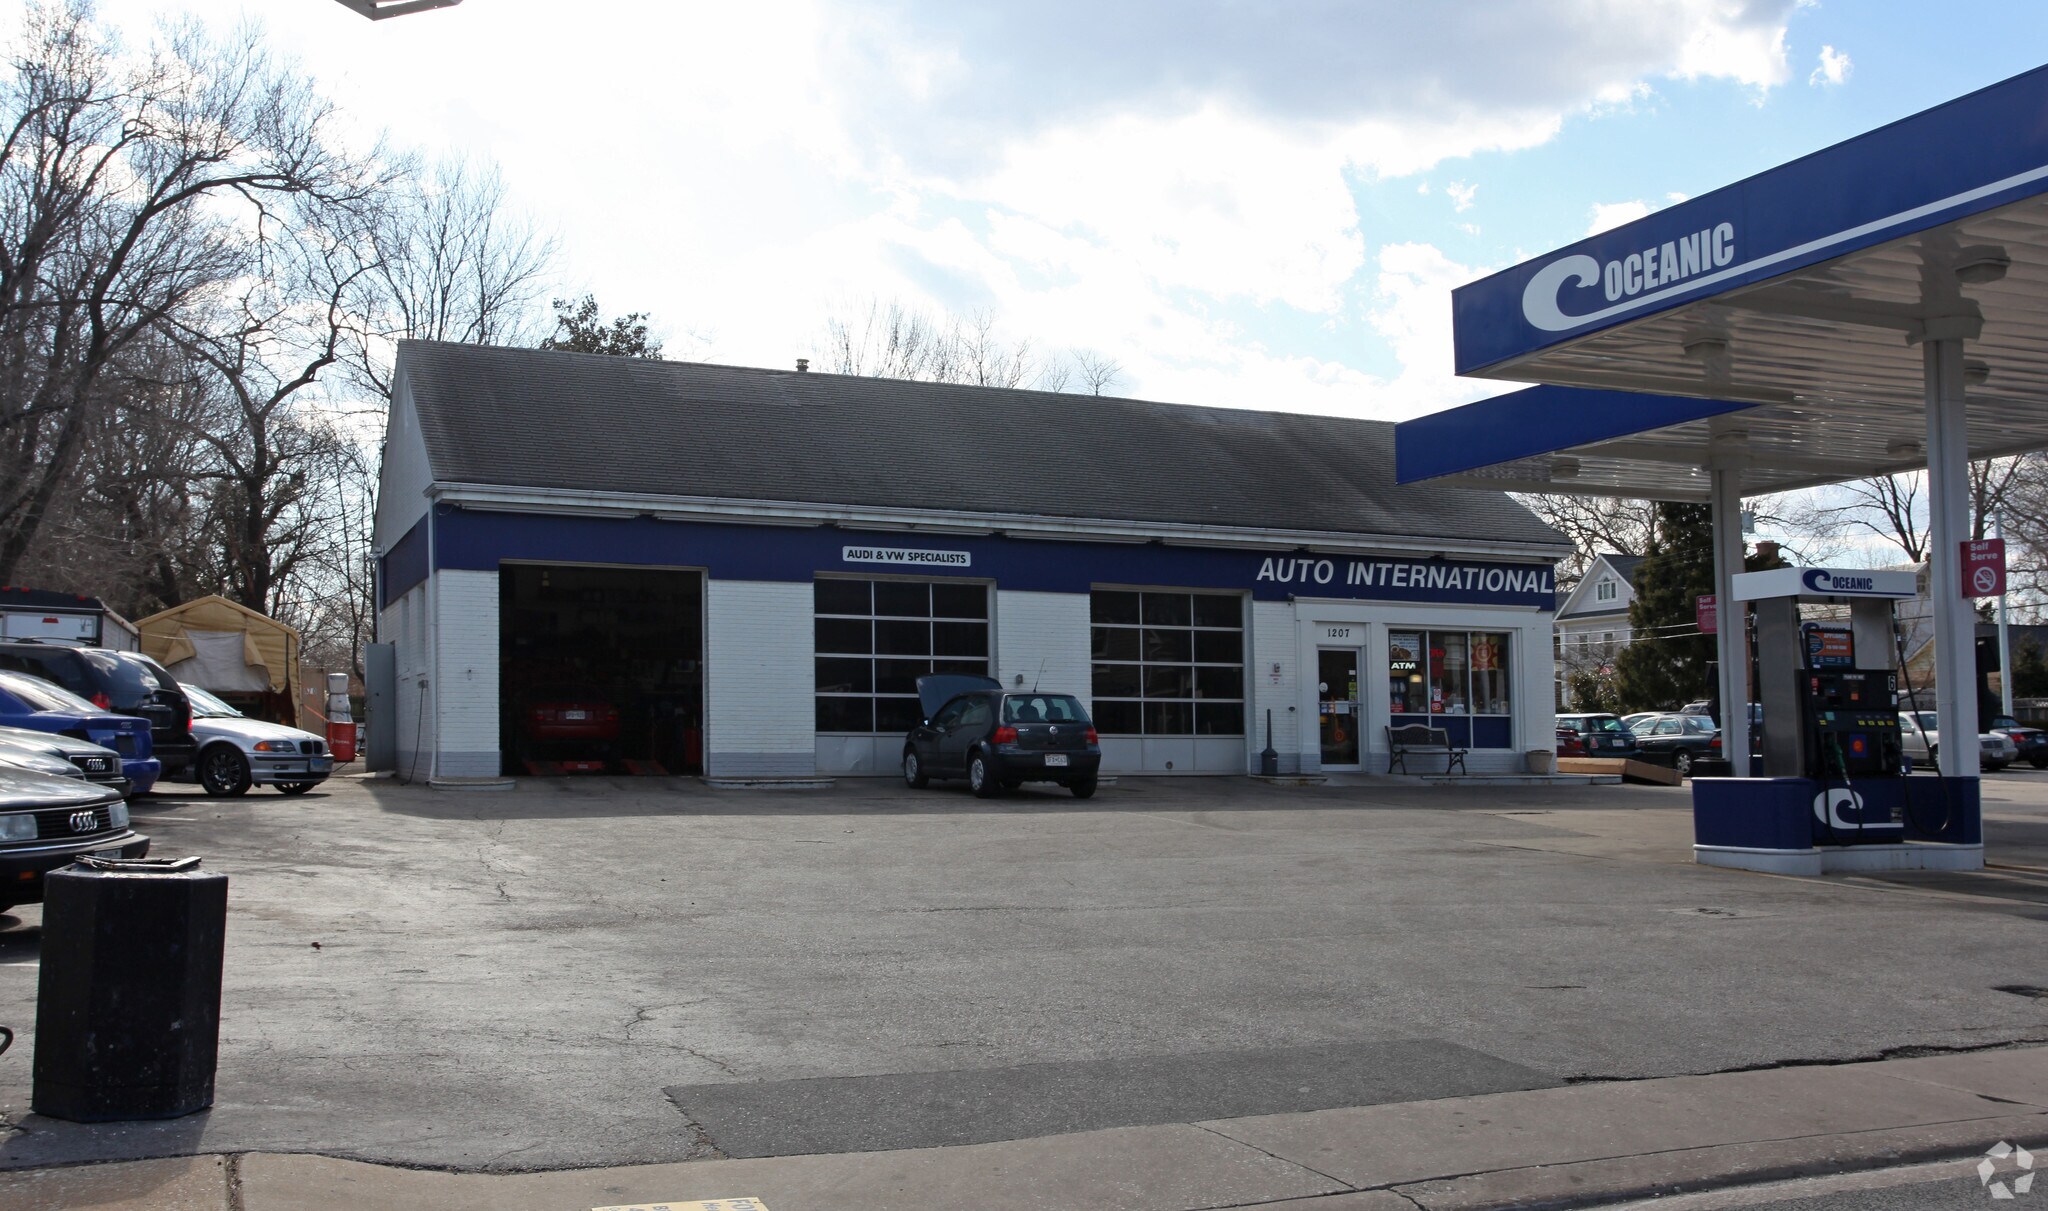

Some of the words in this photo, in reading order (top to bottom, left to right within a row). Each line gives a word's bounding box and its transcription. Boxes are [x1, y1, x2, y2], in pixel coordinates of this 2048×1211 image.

[1604, 222, 1735, 302] OCEANIC
[1970, 542, 1989, 551] Self
[847, 549, 873, 560] AUDI
[875, 550, 884, 560] &
[885, 551, 905, 561] VW
[908, 551, 967, 564] SPECIALISTS
[1970, 552, 1998, 561] Serve
[1256, 557, 1335, 585] AUTO
[1346, 561, 1554, 594] INTERNATIONAL
[1832, 575, 1873, 591] OCEANIC
[1327, 628, 1350, 638] 1207
[1390, 662, 1416, 670] ATM
